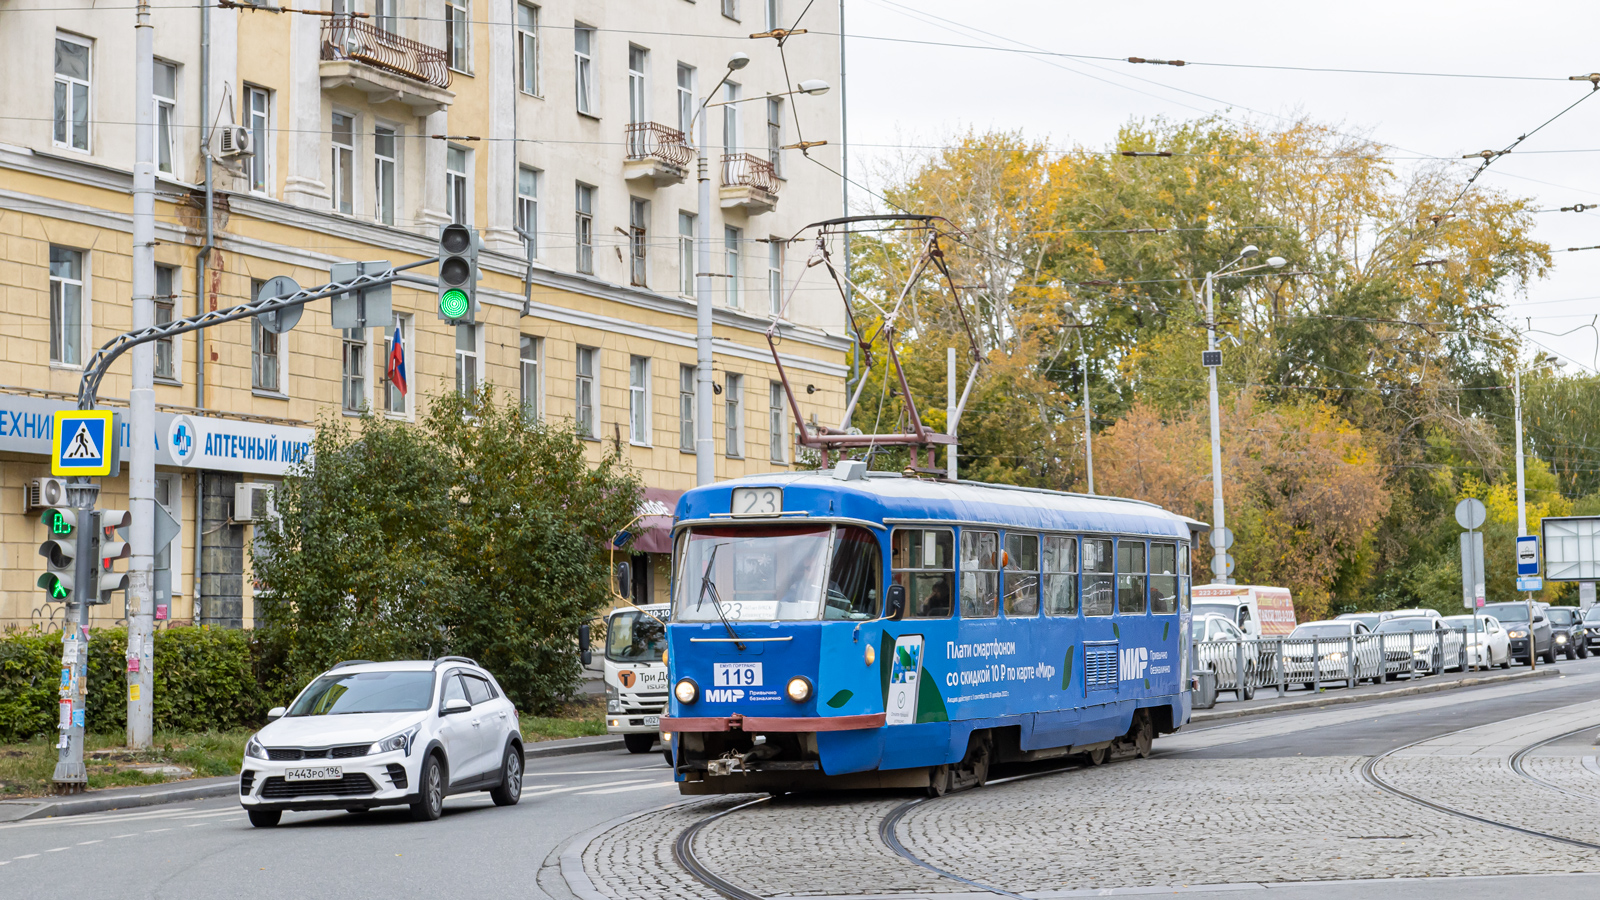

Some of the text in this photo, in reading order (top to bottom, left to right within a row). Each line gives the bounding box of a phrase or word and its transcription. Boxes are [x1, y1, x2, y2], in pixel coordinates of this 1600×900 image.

[0, 410, 54, 440] ЕХНИ
[204, 432, 309, 465] АПТЕЧНЫЙ МИР
[744, 491, 776, 514] 23
[721, 602, 743, 620] 23
[946, 638, 1016, 660] Плати смартфоном
[946, 672, 959, 687] со
[960, 664, 991, 687] скидкой
[991, 664, 999, 682] 10
[1007, 667, 1016, 681] по
[1016, 666, 1034, 683] карте
[1035, 662, 1056, 682] «Мир»
[1119, 646, 1148, 681] МИР
[639, 672, 656, 683] Три
[722, 668, 755, 685] 119
[705, 689, 745, 703] МИР
[288, 768, 324, 779] Р443РО
[325, 767, 340, 775] 196
